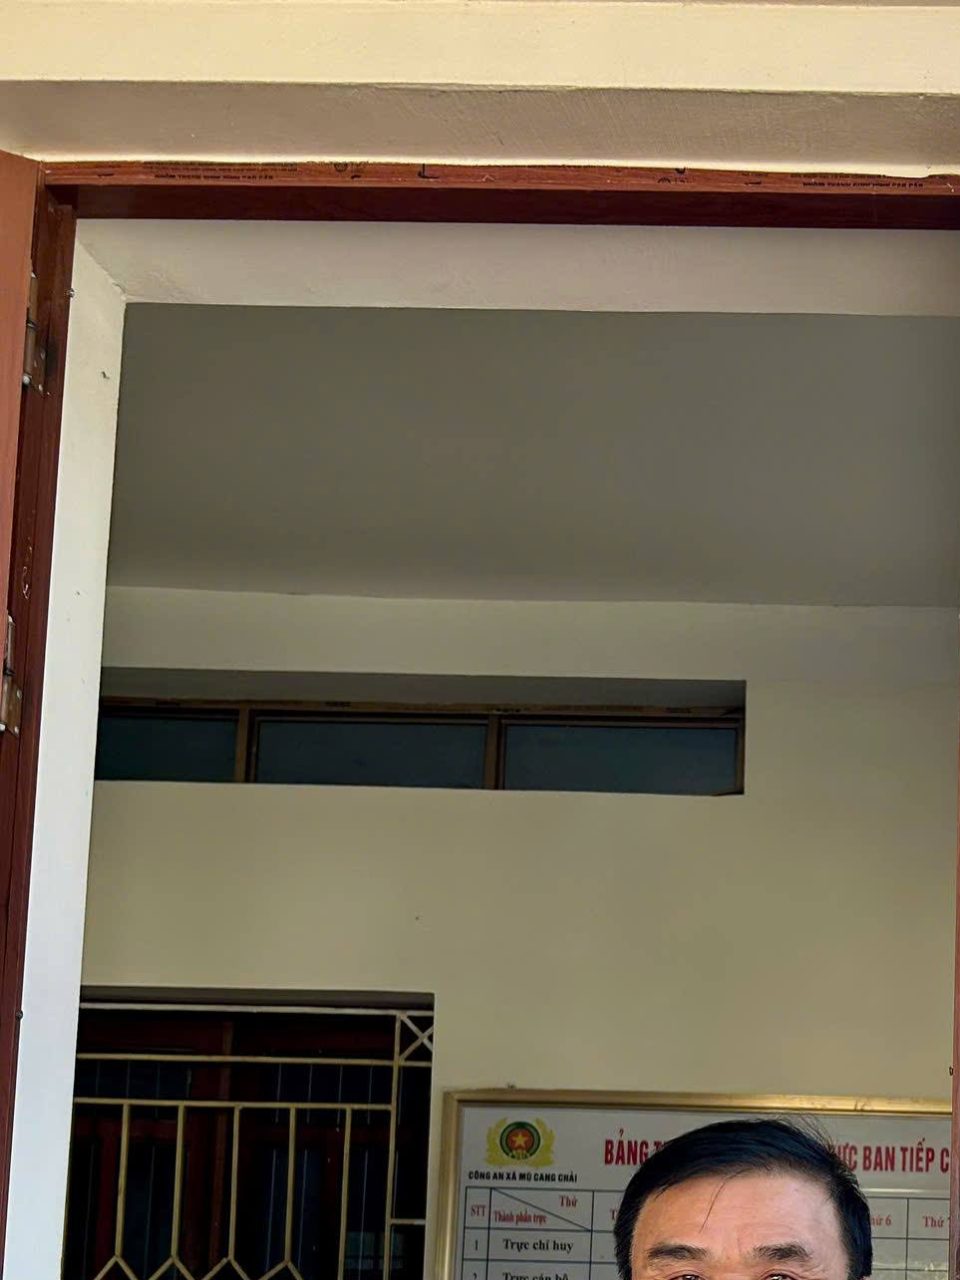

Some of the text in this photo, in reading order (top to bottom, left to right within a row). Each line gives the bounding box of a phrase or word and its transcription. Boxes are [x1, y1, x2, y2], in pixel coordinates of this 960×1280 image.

[605, 1128, 649, 1165] BẢNG
[863, 1146, 895, 1171] BAN
[901, 1138, 935, 1172] TIẾP
[492, 1172, 503, 1180] AN
[533, 1173, 555, 1182] CANG
[471, 1205, 485, 1217] STT
[475, 1240, 478, 1250] 1
[503, 1239, 529, 1252] Trực
[553, 1240, 573, 1255] huy
